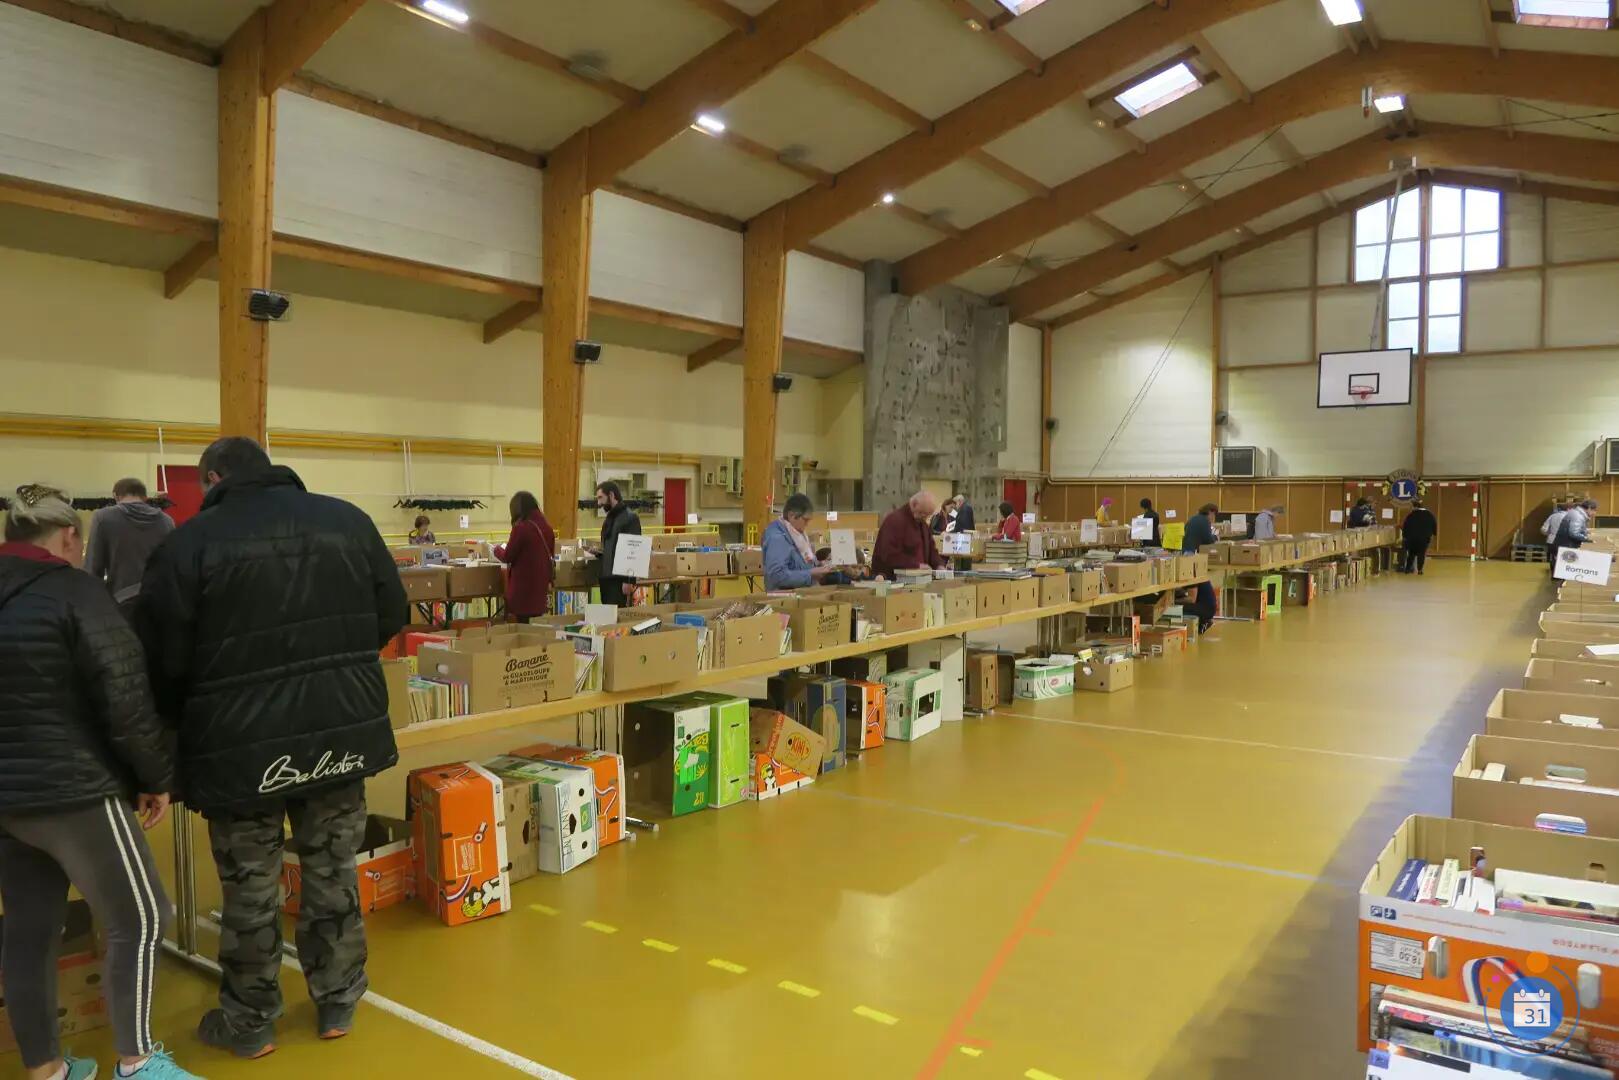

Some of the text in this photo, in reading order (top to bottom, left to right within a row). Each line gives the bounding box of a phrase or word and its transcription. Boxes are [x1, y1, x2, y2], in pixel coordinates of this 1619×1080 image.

[1397, 481, 1411, 498] L
[1565, 565, 1599, 576] Romans
[505, 654, 553, 672] Banane
